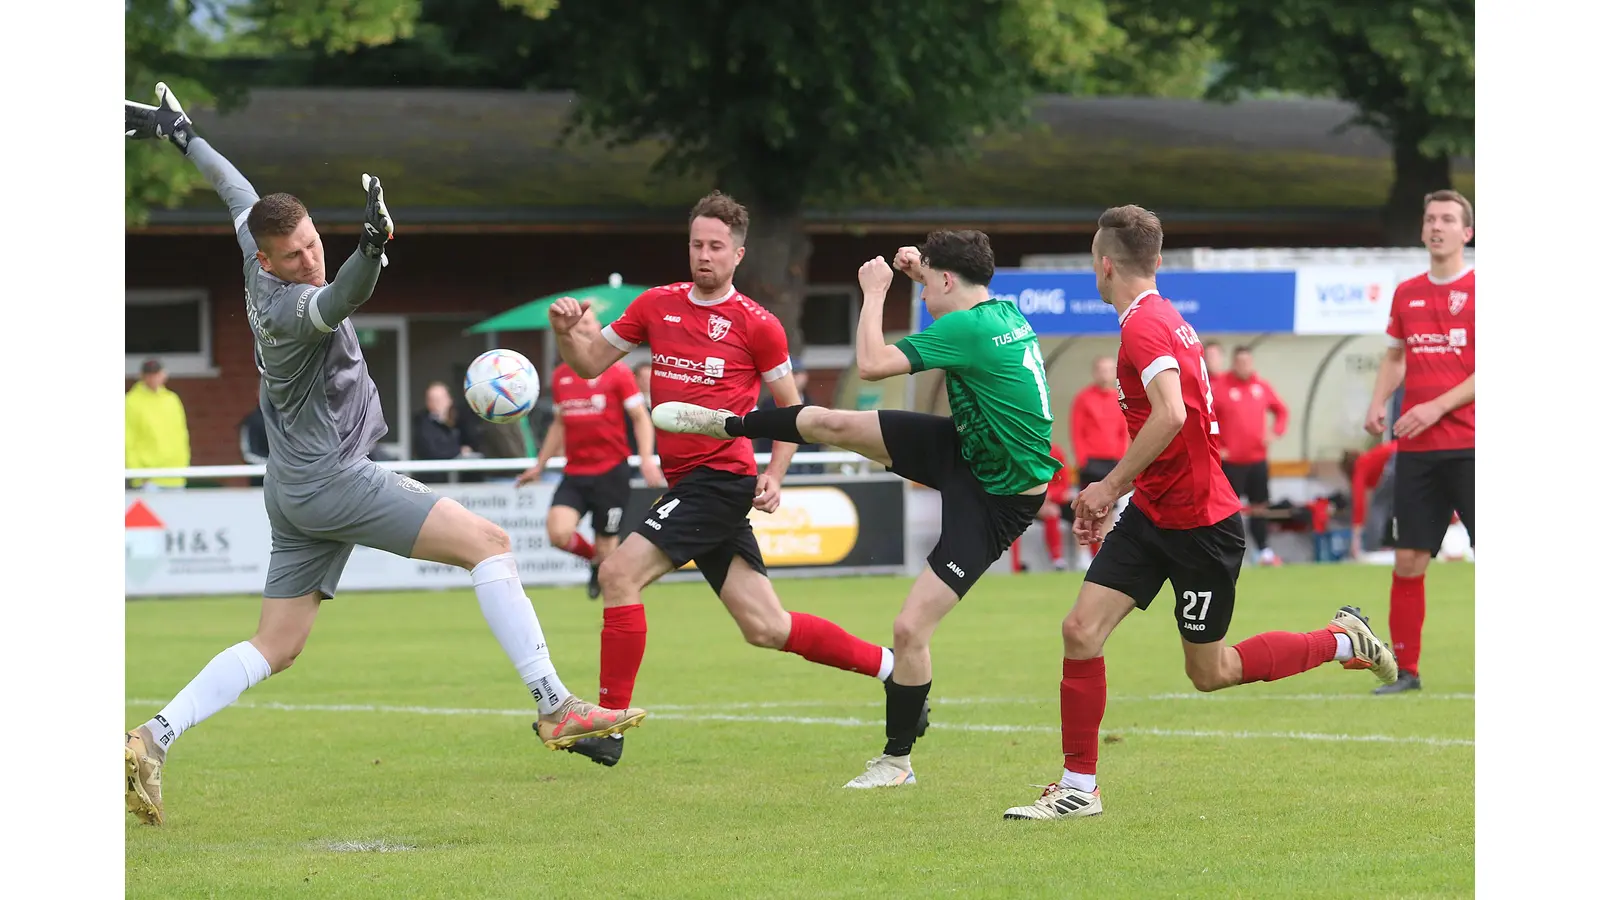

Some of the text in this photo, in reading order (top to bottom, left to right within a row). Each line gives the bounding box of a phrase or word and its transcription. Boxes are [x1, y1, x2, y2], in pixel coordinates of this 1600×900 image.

[663, 315, 681, 323] JAKO
[992, 332, 1013, 347] TUS
[656, 498, 680, 519] 4
[644, 518, 661, 531] JAKO
[165, 529, 186, 553] H
[946, 561, 965, 578] JAKO
[1183, 590, 1212, 620] 27
[1184, 622, 1206, 631] JAKO
